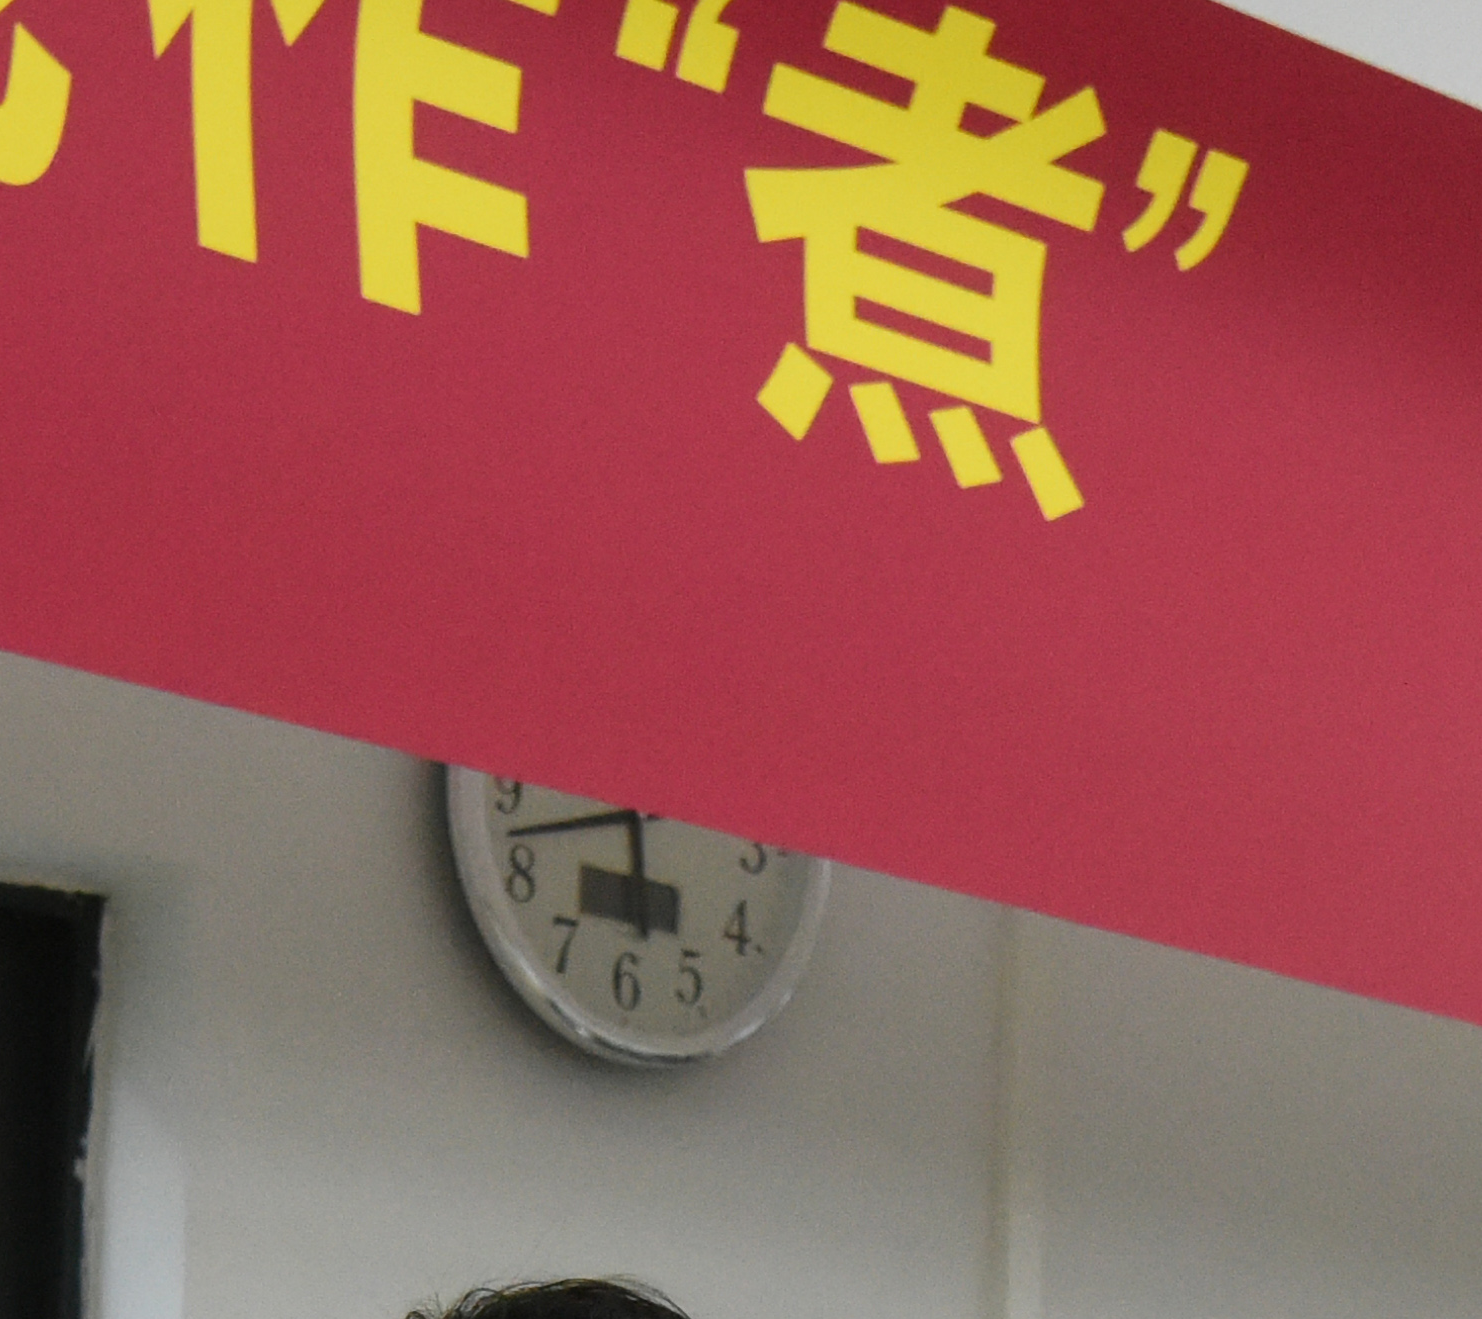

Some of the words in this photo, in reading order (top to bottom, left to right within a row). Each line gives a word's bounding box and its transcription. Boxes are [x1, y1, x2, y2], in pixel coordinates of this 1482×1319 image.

[506, 844, 536, 903] 8
[552, 915, 580, 974] 7
[723, 899, 752, 957] 4
[613, 950, 642, 1012] 6
[676, 948, 704, 1006] 5
